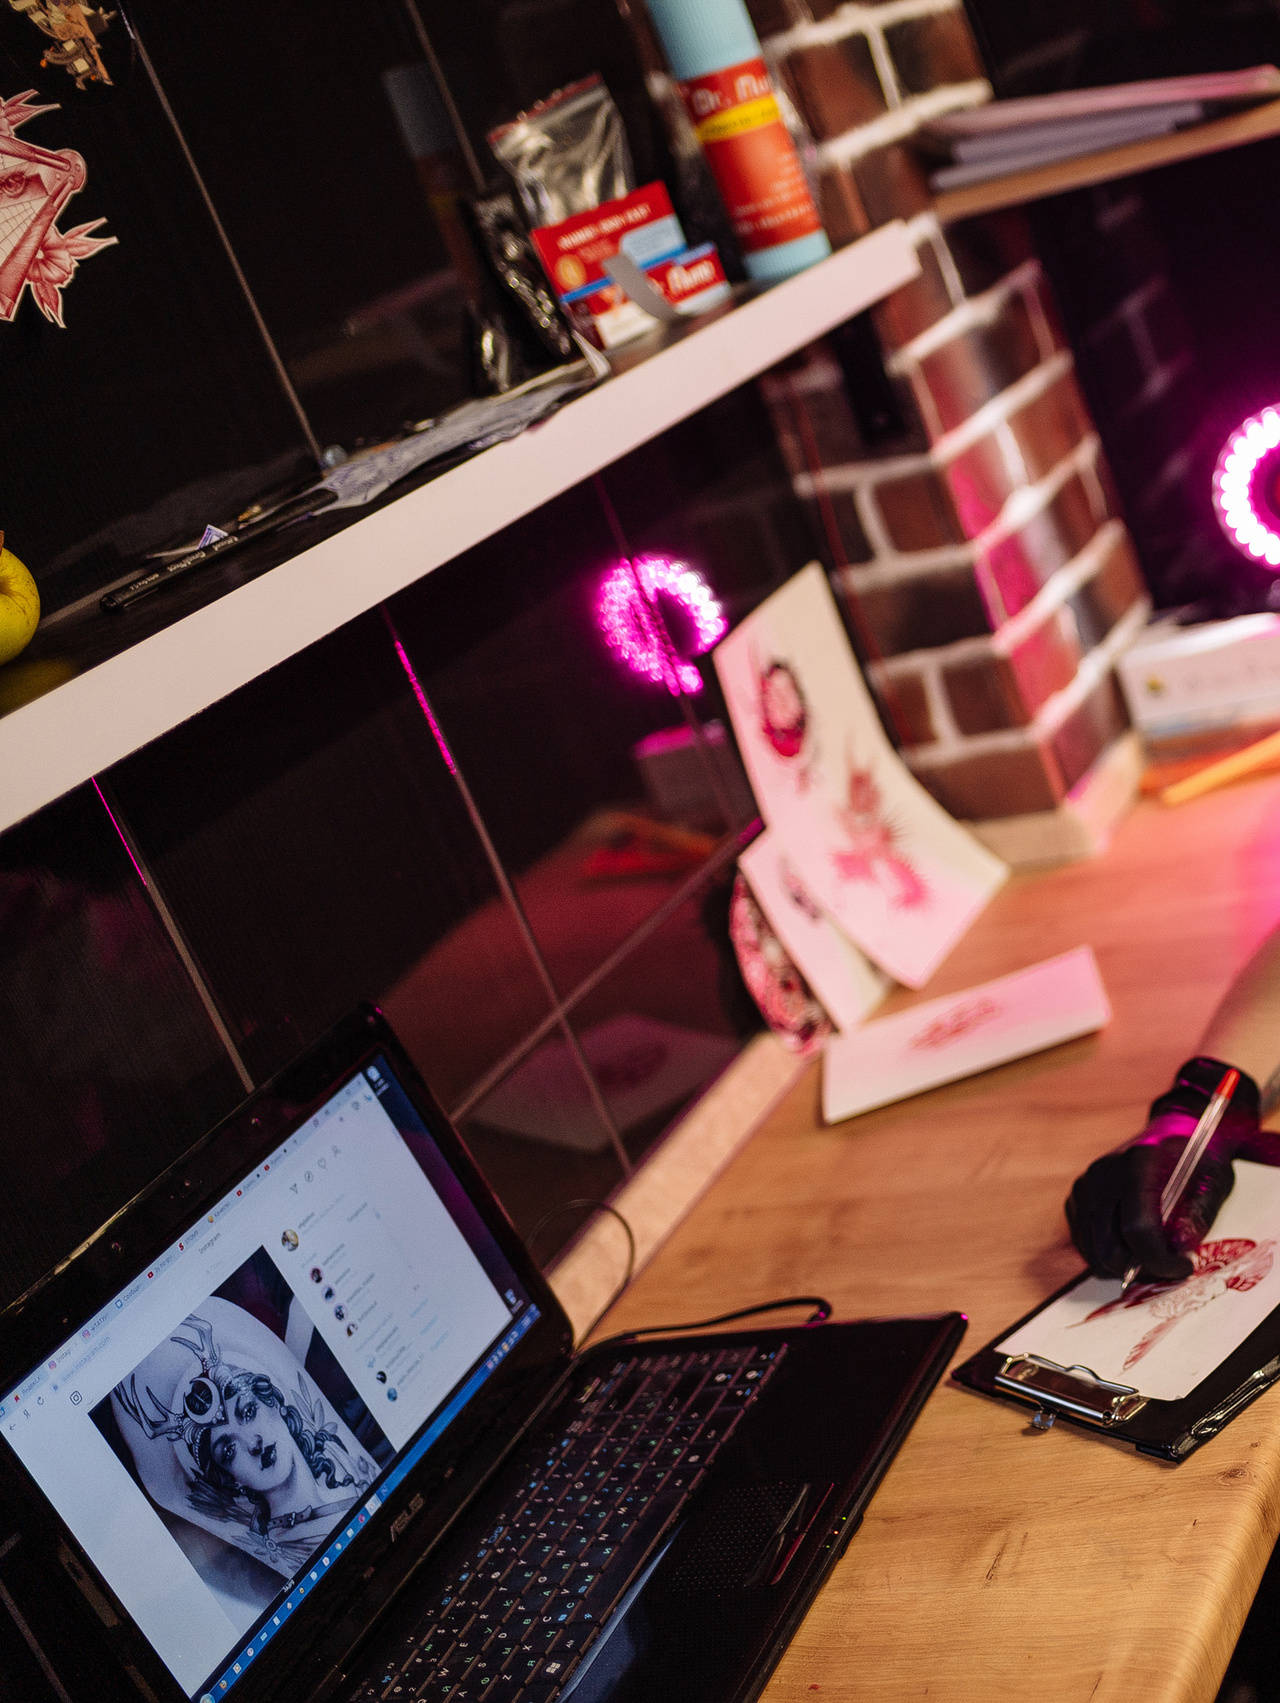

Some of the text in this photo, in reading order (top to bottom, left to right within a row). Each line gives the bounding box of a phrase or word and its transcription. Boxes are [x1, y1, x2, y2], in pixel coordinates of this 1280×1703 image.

[197, 1231, 222, 1255] Instagram
[61, 1335, 111, 1383] www.instagram.com
[390, 1492, 425, 1543] ASUS
[438, 1668, 449, 1677] W
